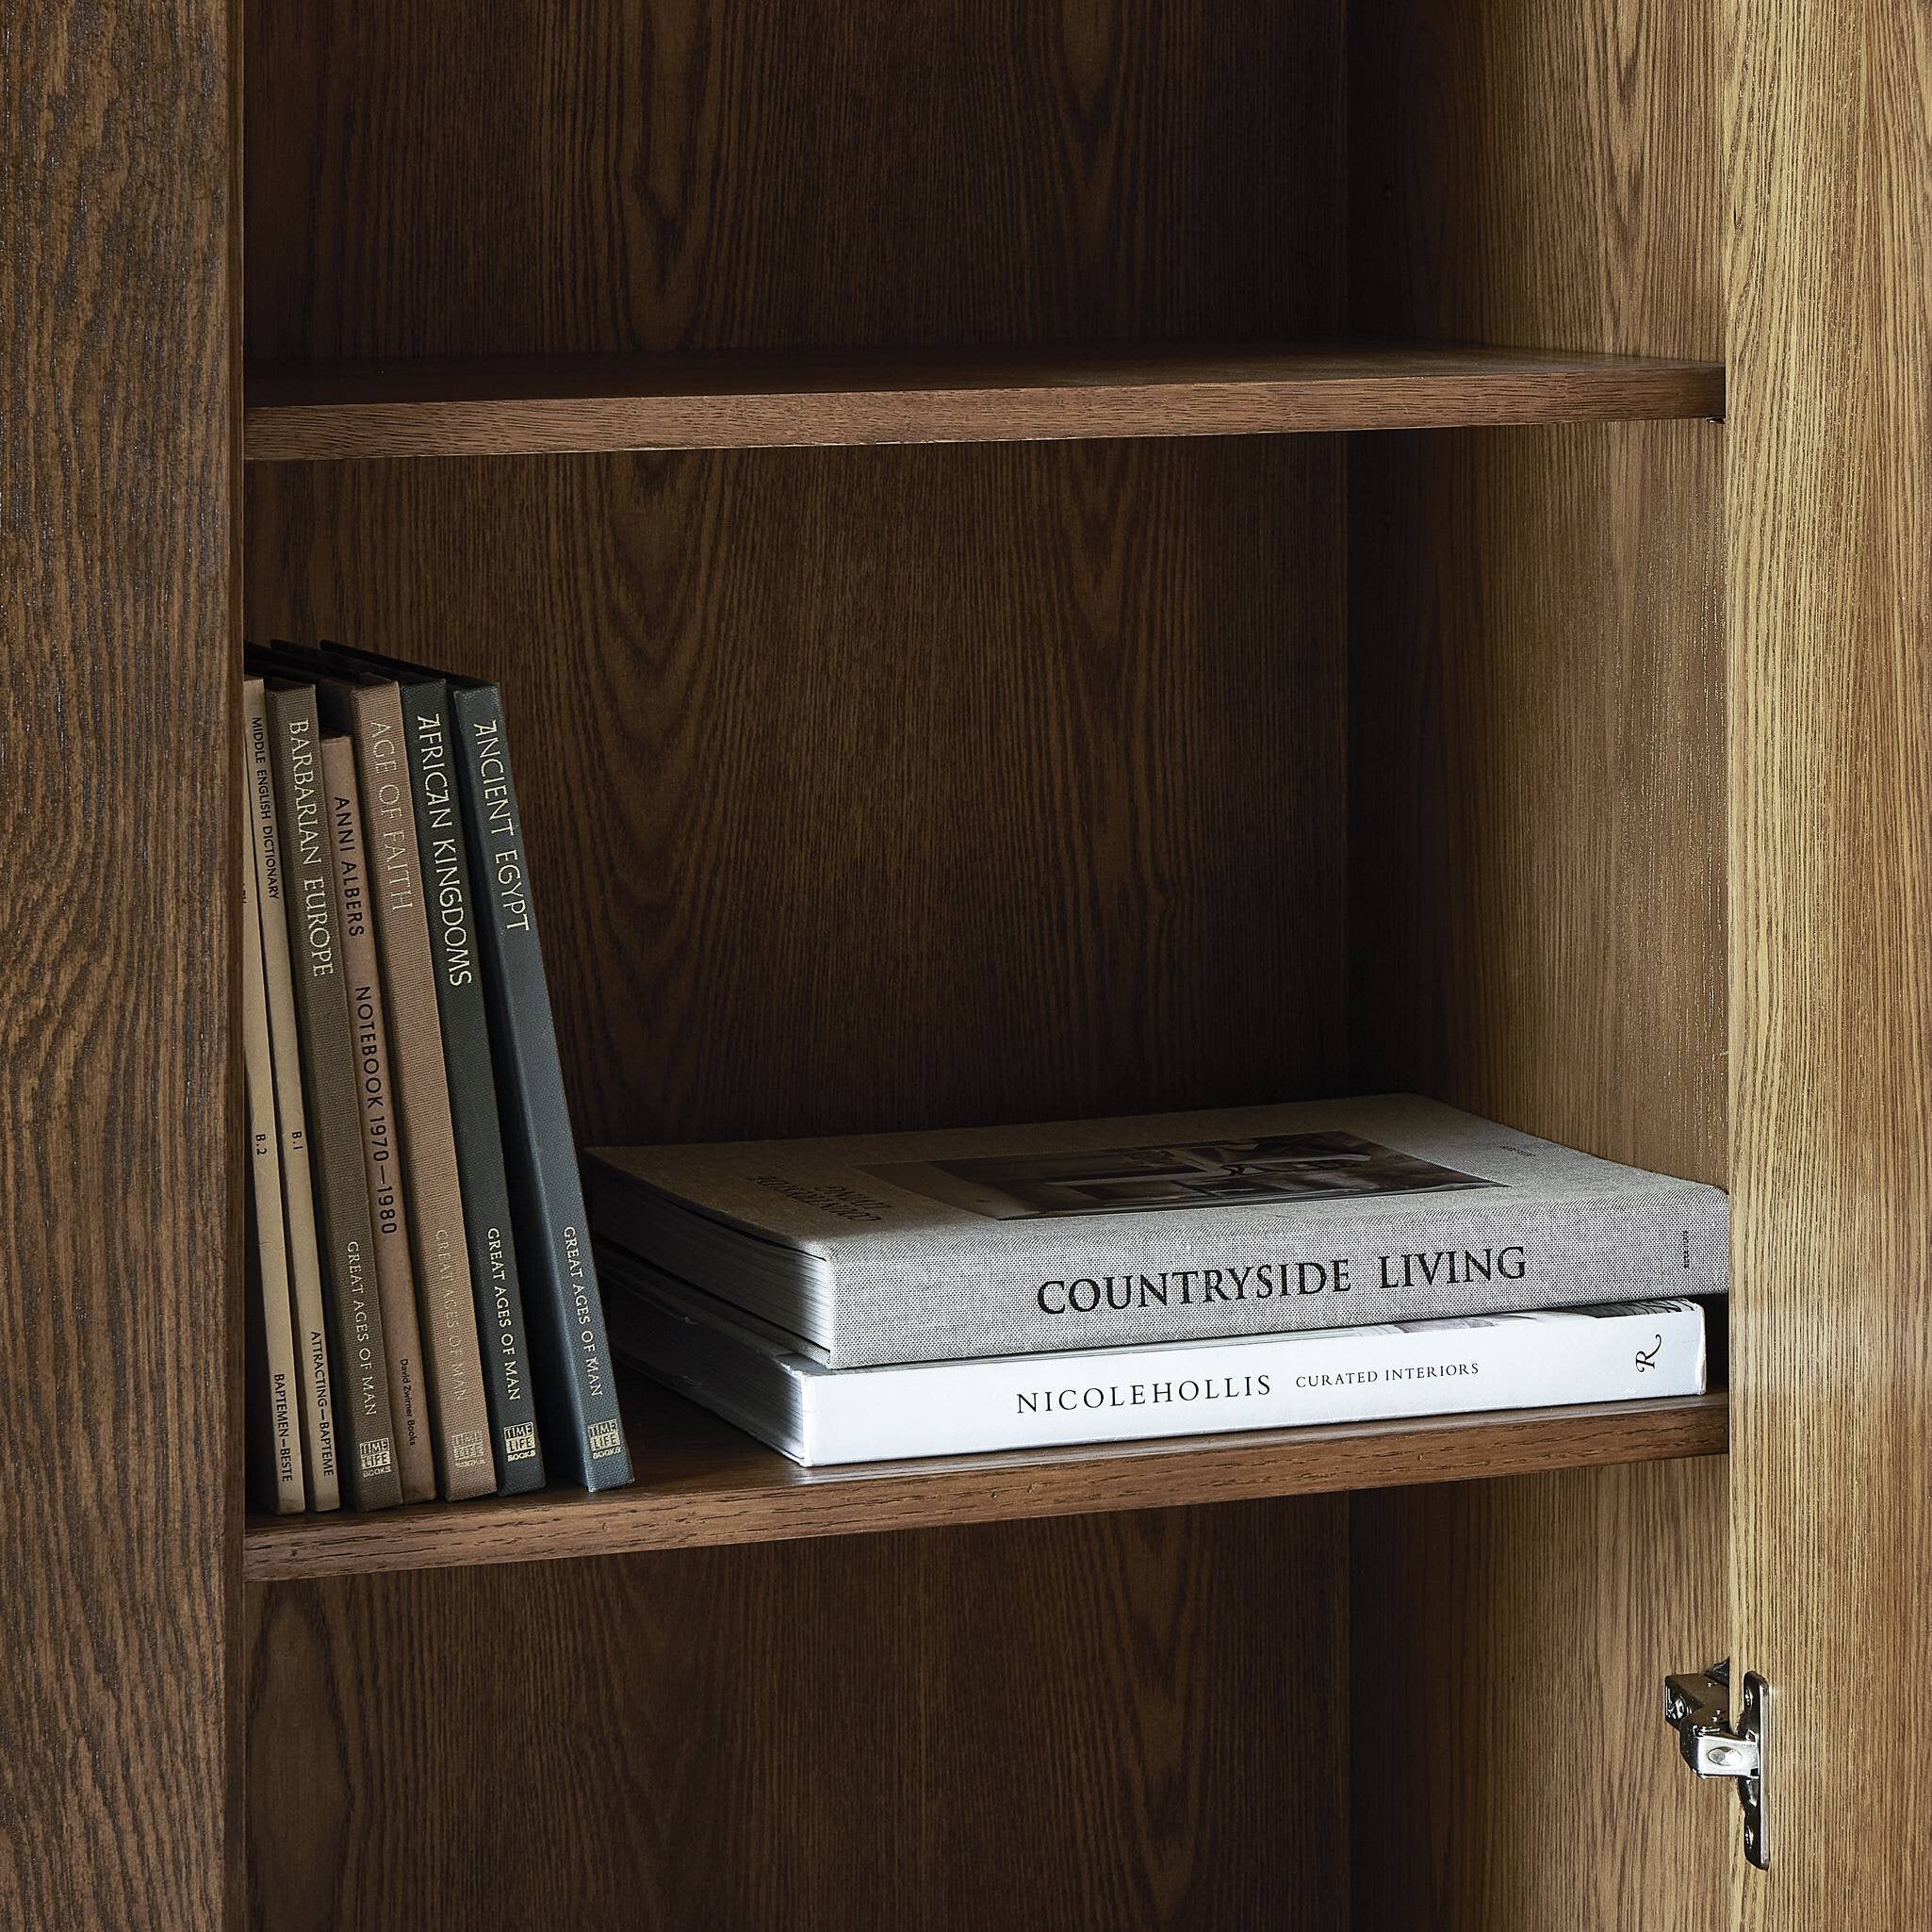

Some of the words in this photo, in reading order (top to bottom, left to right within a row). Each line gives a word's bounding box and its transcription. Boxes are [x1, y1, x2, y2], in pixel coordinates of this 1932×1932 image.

[252, 717, 265, 763] MIDDLE
[370, 722, 397, 774] AGE
[418, 713, 452, 828] AFRICAN
[256, 769, 271, 819] ENGLISH
[289, 719, 321, 864] BARBARIAN
[378, 784, 402, 819] OF
[334, 797, 355, 851] ANNI
[473, 719, 515, 836] ANCIENT
[495, 849, 530, 932] EGYPT
[262, 826, 279, 899] DICTIONARY
[384, 830, 413, 910] FAITH
[341, 861, 365, 937] ALBERS
[433, 839, 472, 986] KINGDOMS
[303, 876, 334, 976] EUROPE
[355, 986, 384, 1107] NOTEBOOK
[255, 1134, 267, 1155] B.2
[347, 1241, 364, 1294] GREAT
[435, 1229, 453, 1281] GREAT
[487, 1228, 505, 1280] GREAT
[565, 1226, 583, 1278] GREAT
[1037, 1258, 1351, 1315] COUNTRYSIDE
[1379, 1246, 1527, 1289] LIVING
[352, 1300, 368, 1342] AGES
[443, 1288, 459, 1329] AGES
[494, 1285, 511, 1328] AGES
[572, 1284, 591, 1324] AGES
[358, 1348, 372, 1370] OF
[501, 1334, 516, 1355] OF
[581, 1330, 596, 1351] OF
[401, 1359, 411, 1384] David
[452, 1363, 467, 1402] MAN
[504, 1360, 520, 1400] MAN
[585, 1356, 603, 1397] MAN
[1016, 1374, 1271, 1414] NICOLEHOLLIS
[1296, 1369, 1379, 1388] CURATED
[1385, 1362, 1481, 1381] INTERIORS
[362, 1376, 377, 1416] MAN
[403, 1385, 414, 1417] Zwirner
[361, 1440, 388, 1455] TIME
[407, 1419, 416, 1446] Books
[505, 1424, 533, 1439] TIME
[508, 1435, 533, 1452] LIFE
[589, 1421, 617, 1437] TIME
[593, 1433, 618, 1449] LIFE
[363, 1452, 390, 1469] LIFE
[363, 1466, 392, 1478] BOOKS
[507, 1450, 536, 1462] BOOKS
